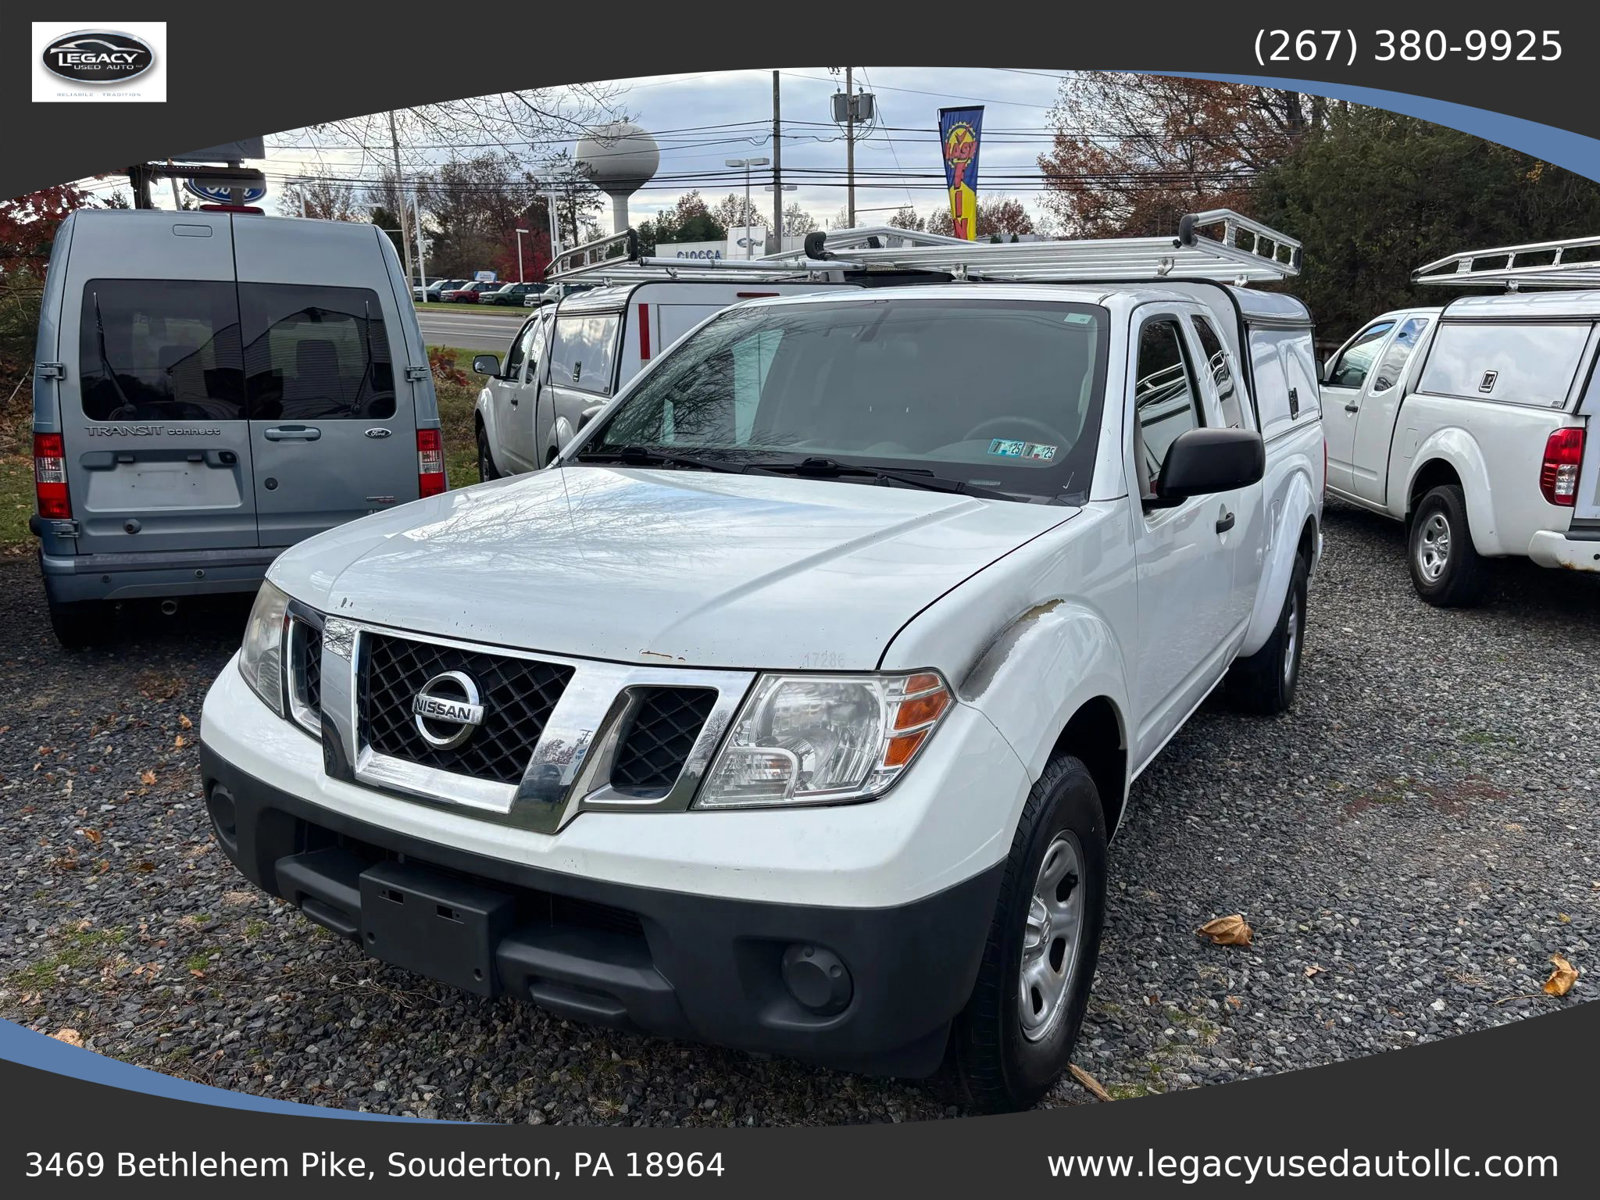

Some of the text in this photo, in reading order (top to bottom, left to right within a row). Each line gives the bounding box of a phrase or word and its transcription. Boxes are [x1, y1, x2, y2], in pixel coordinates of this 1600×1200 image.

[84, 425, 221, 436] TRANSIT connect
[414, 697, 472, 720] NISSAN
